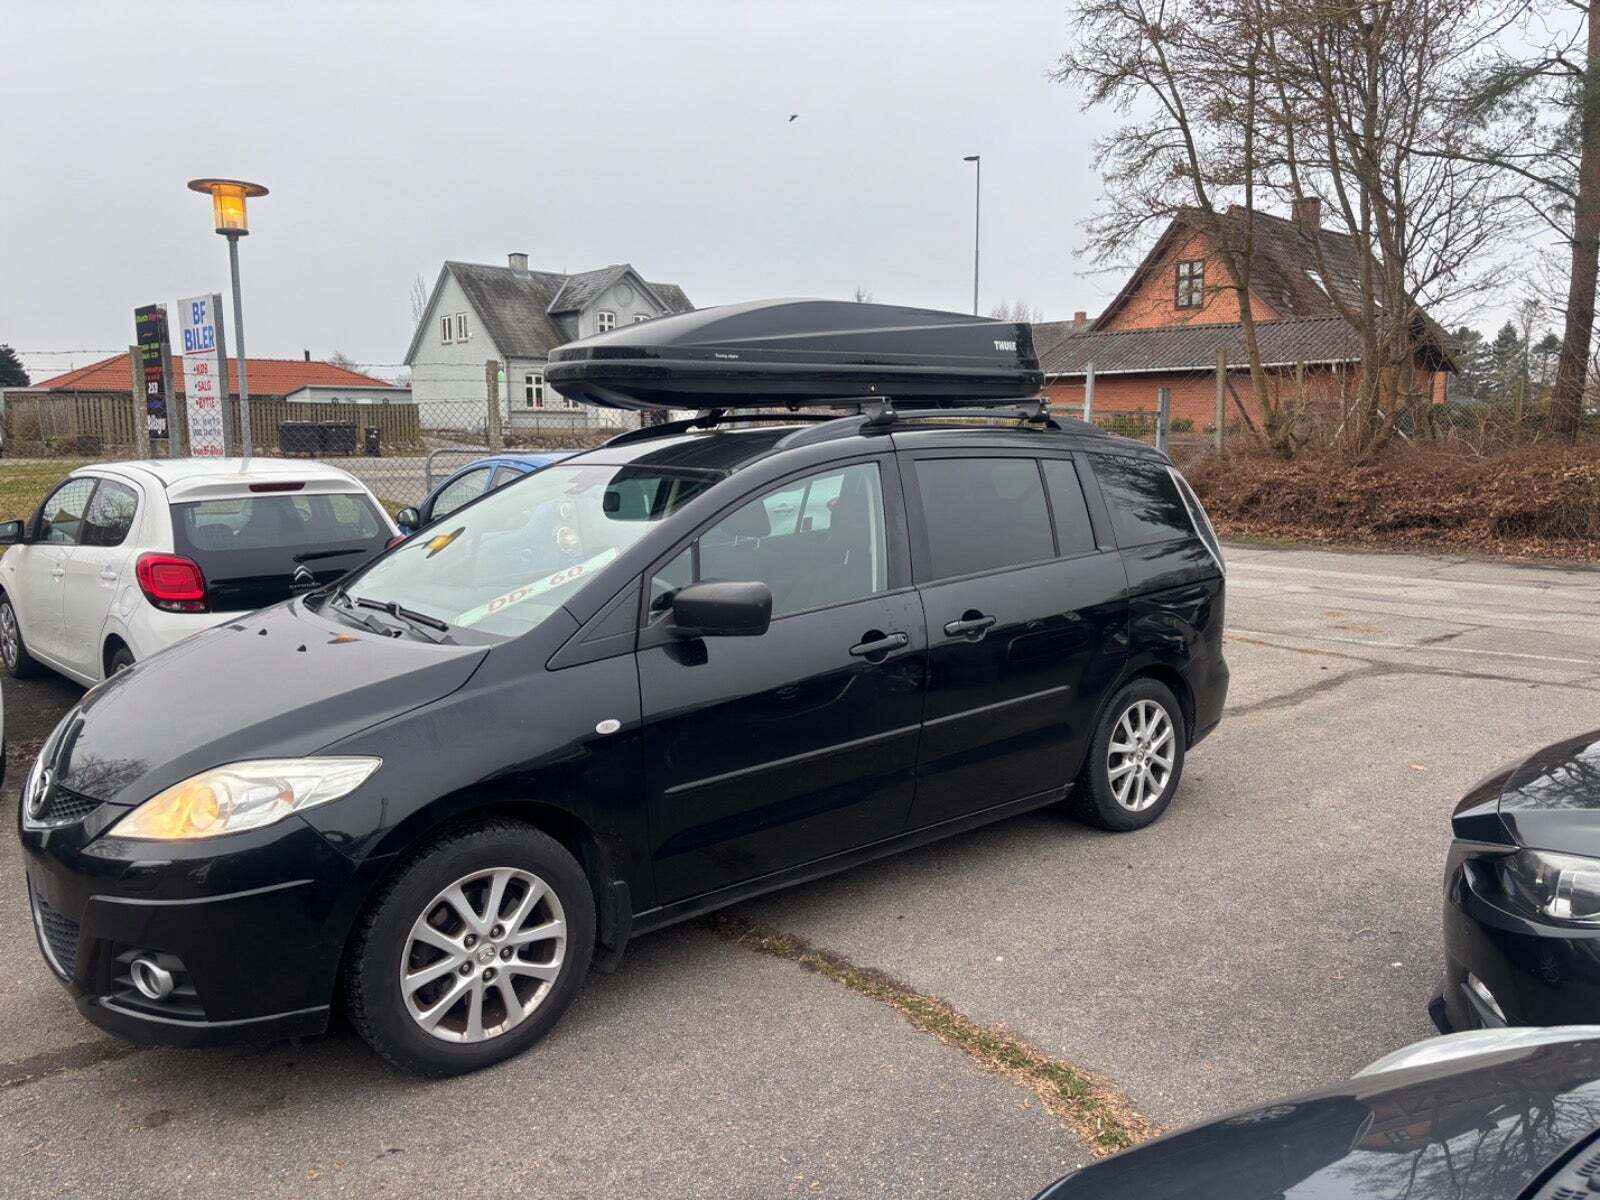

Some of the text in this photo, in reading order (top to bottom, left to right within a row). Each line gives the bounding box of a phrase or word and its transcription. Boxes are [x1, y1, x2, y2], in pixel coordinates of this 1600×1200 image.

[192, 301, 206, 325] BF
[184, 325, 215, 351] BILER
[993, 340, 1017, 351] THULE
[197, 380, 211, 392] SALG
